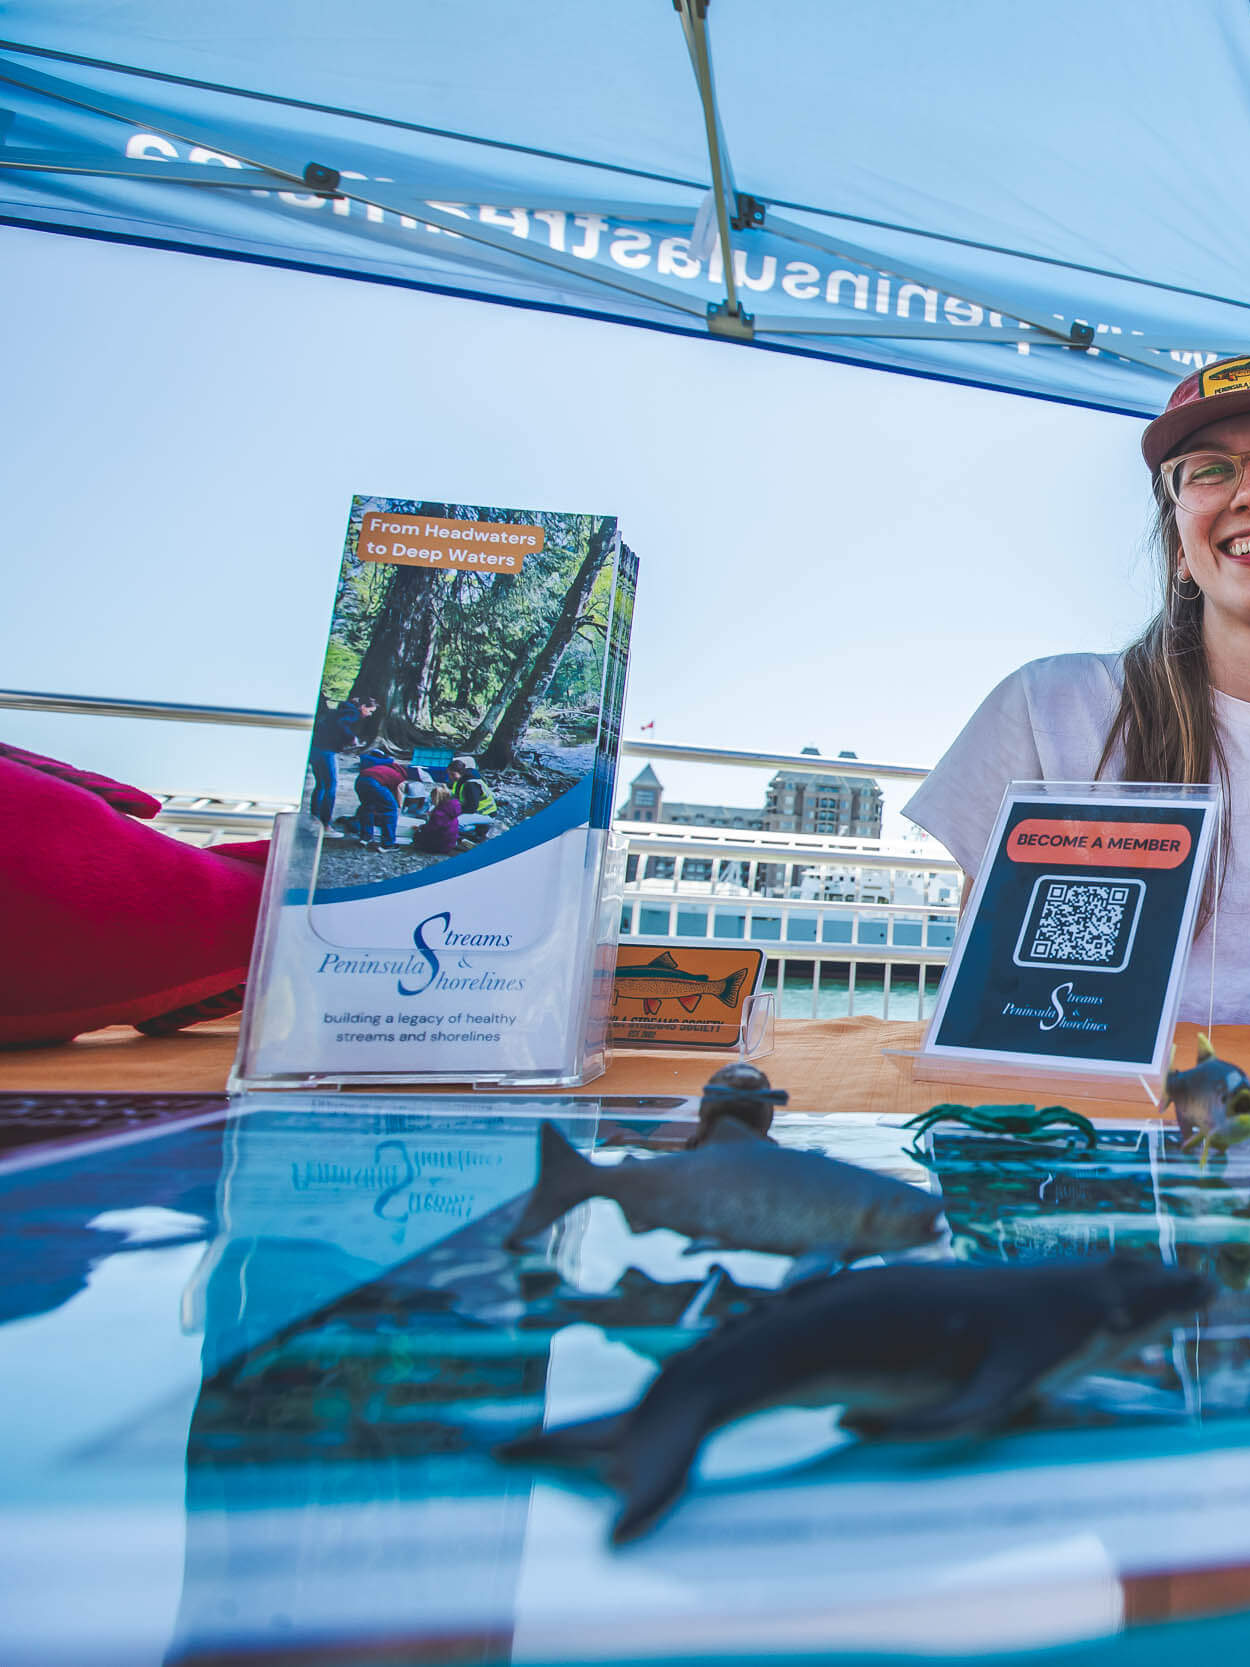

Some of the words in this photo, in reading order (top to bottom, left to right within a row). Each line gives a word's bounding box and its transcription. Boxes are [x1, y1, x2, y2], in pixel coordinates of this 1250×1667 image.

[370, 518, 420, 536] From
[424, 524, 537, 546] Headwaters
[366, 541, 388, 555] to
[391, 543, 443, 563] Deep
[448, 548, 516, 567] Waters
[1016, 833, 1088, 848] BECOME
[1091, 836, 1103, 848] A
[1108, 837, 1181, 852] MEMBER
[316, 952, 425, 975] Peninsula
[457, 954, 473, 969] &
[1002, 1002, 1056, 1018] Peninsula
[323, 1013, 381, 1026] building
[386, 1015, 394, 1024] a
[398, 1013, 443, 1026] legacy
[448, 1013, 462, 1024] of
[466, 1013, 517, 1026] healthy
[335, 1033, 395, 1042] streams
[399, 1032, 426, 1042] and
[430, 1032, 501, 1042] shorelines
